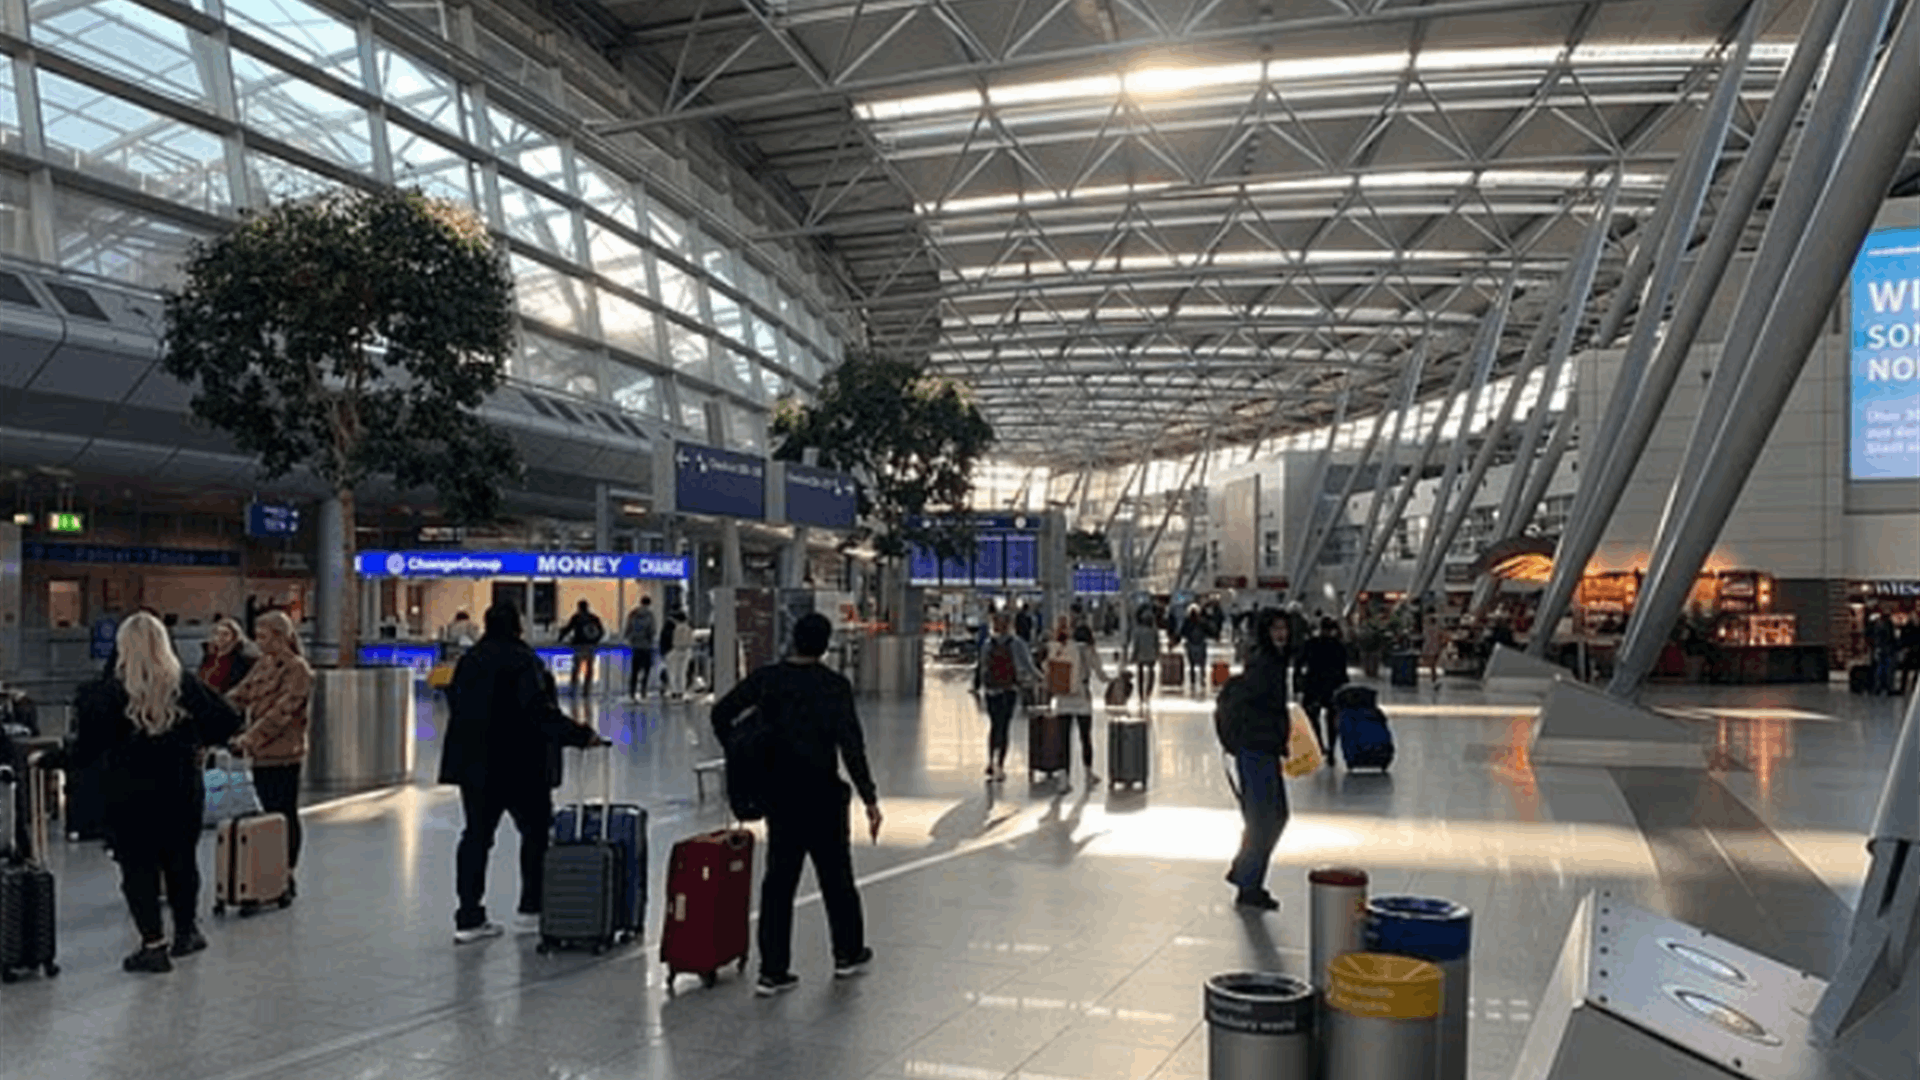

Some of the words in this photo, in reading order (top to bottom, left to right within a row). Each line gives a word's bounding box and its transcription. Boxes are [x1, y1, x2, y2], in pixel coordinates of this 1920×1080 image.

[1868, 355, 1920, 383] NO
[408, 556, 502, 573] ChangeGroup
[537, 555, 622, 574] MONEY
